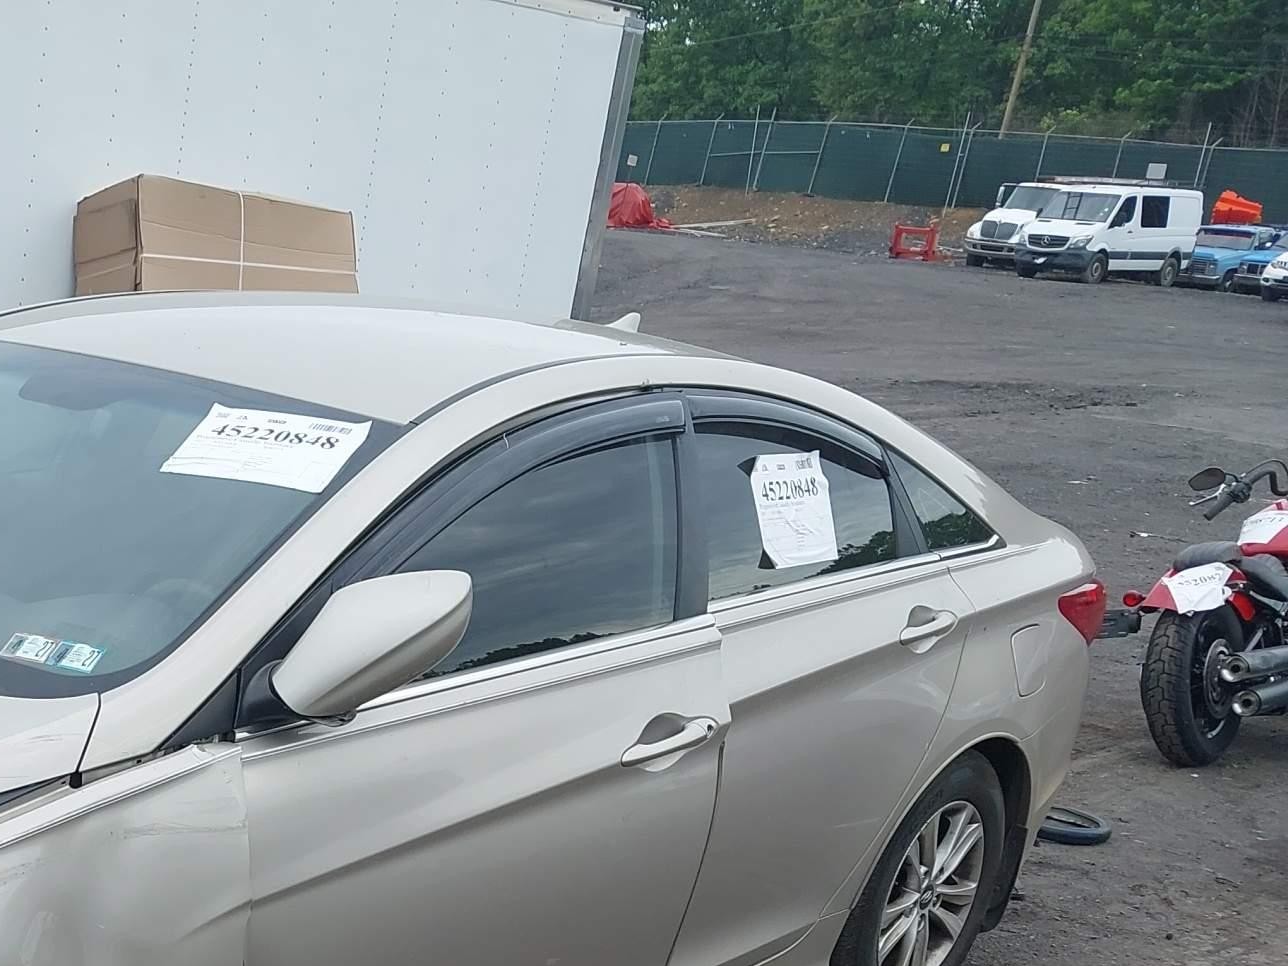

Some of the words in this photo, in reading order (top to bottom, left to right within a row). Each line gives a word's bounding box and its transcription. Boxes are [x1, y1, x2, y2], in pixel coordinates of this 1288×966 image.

[212, 423, 340, 450] 45220848
[762, 478, 819, 501] 45220848
[35, 640, 55, 659] 27
[81, 650, 101, 668] 27
